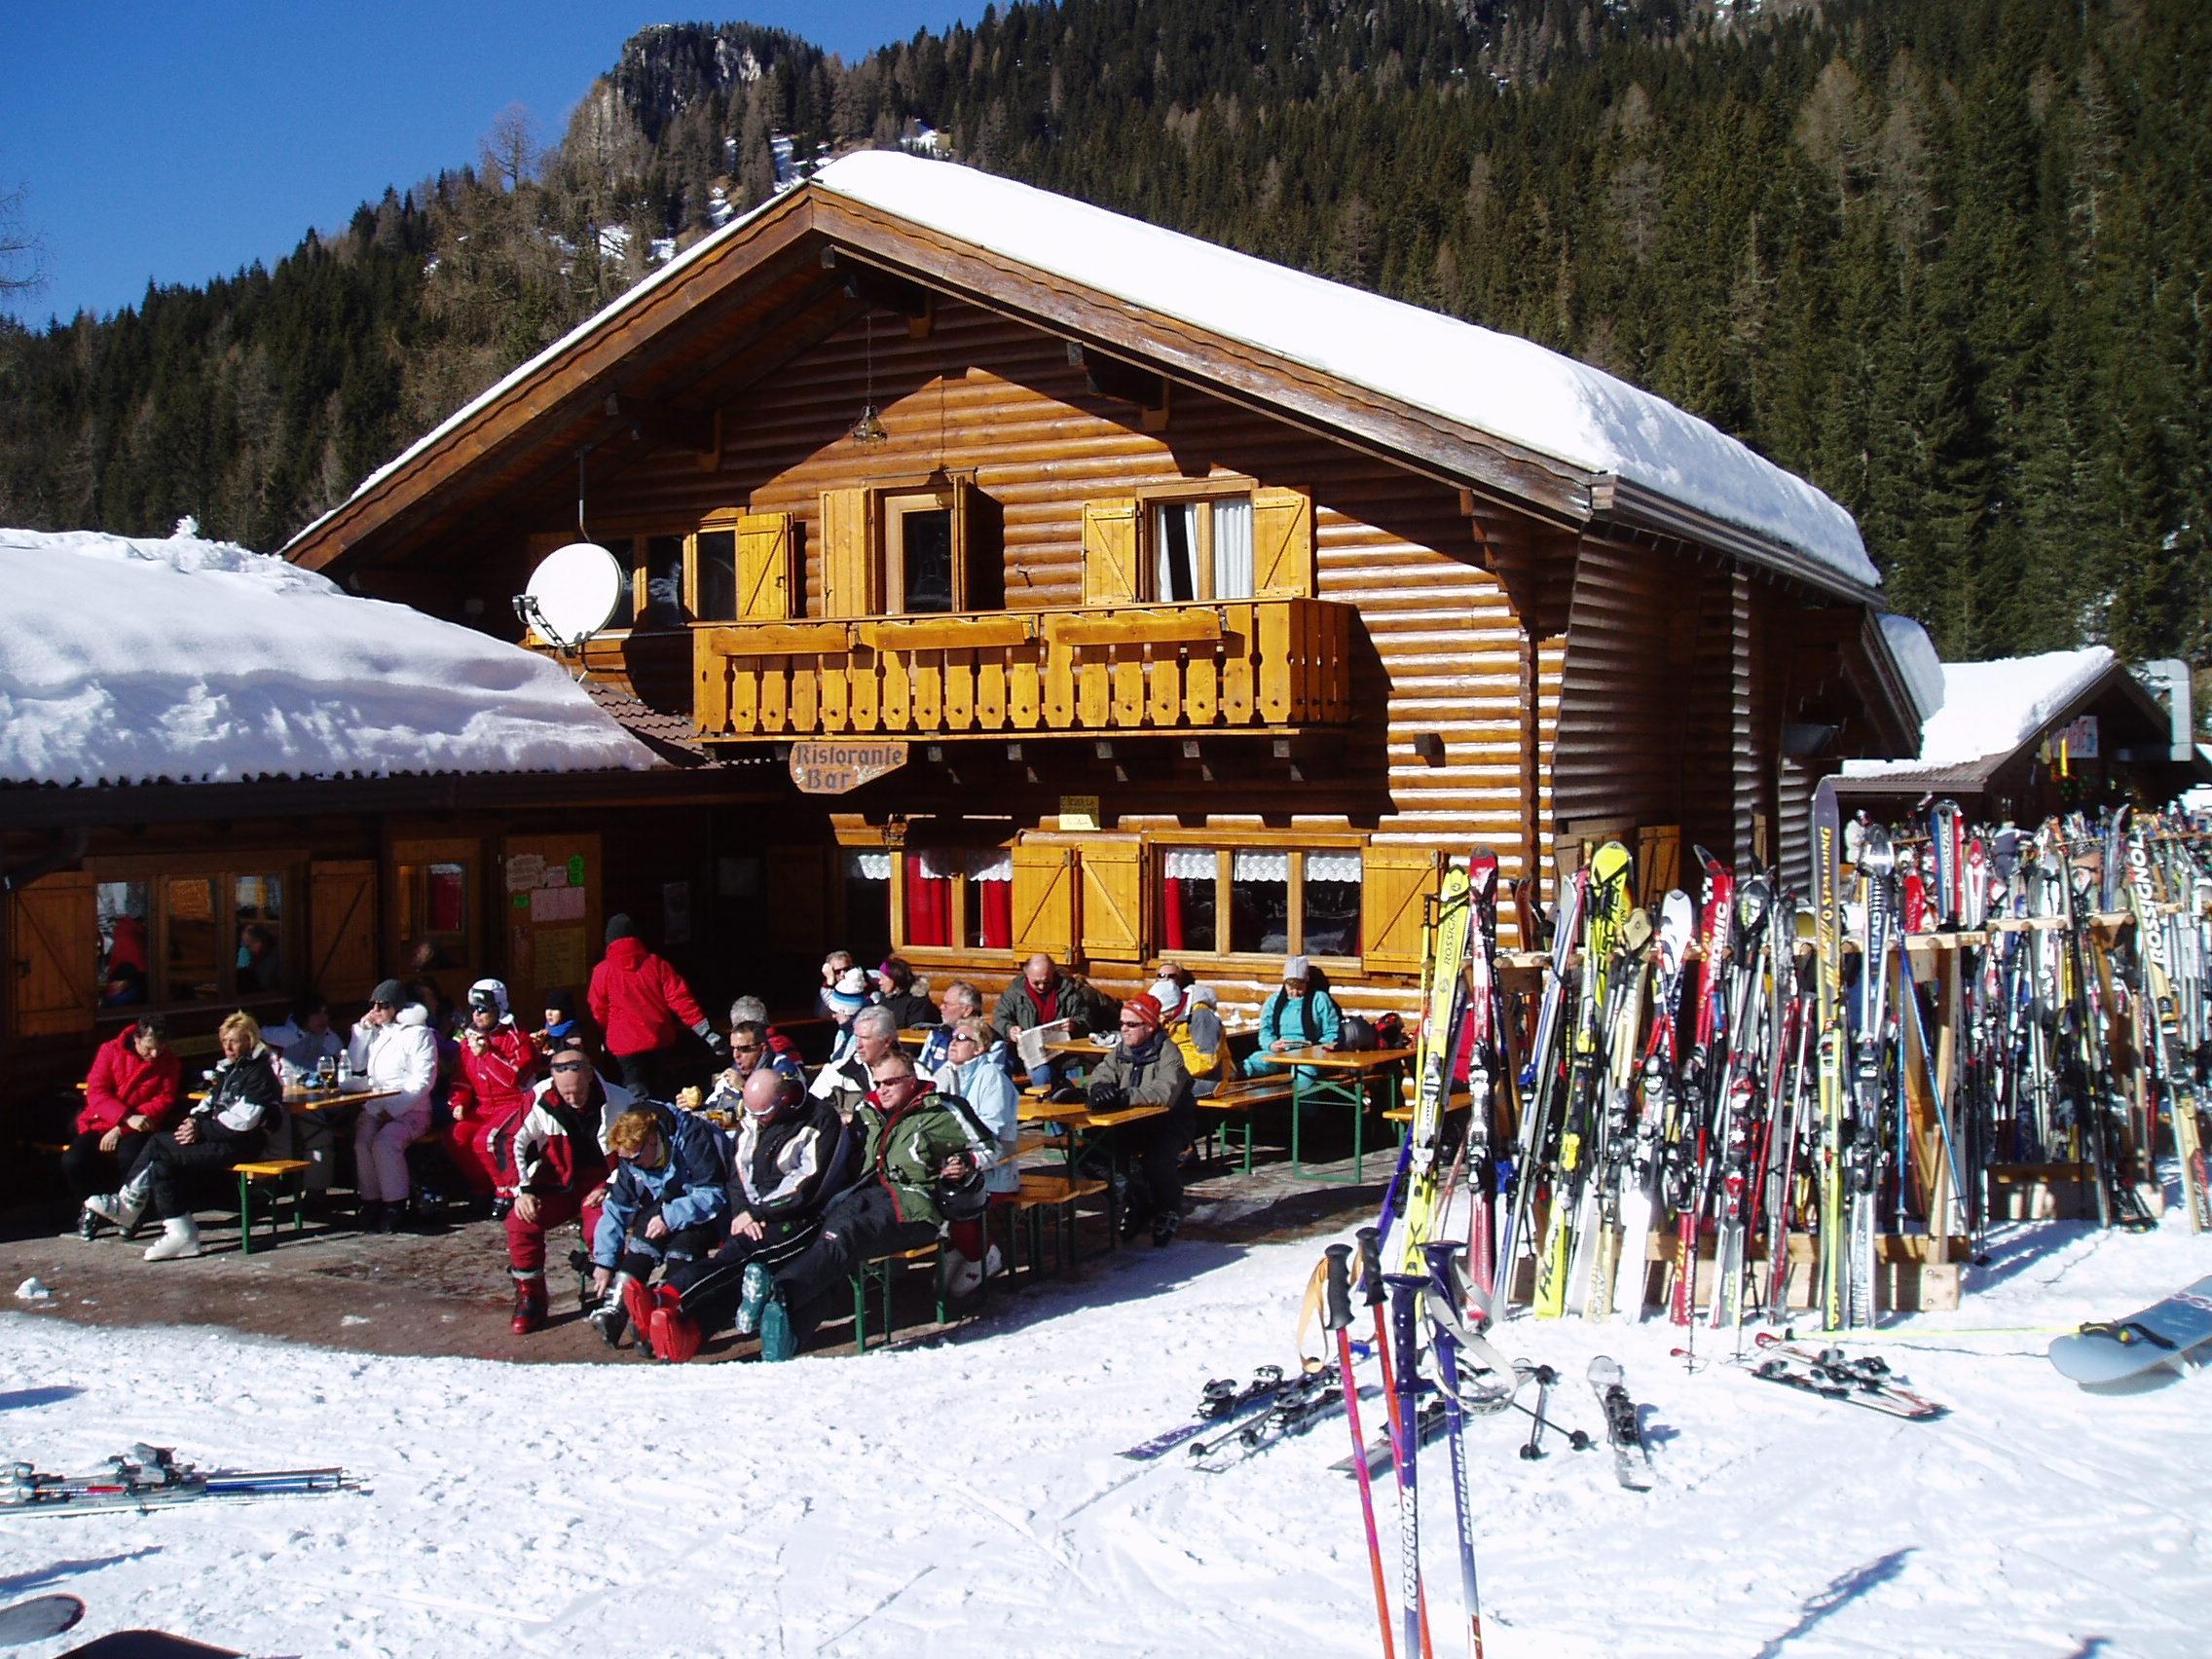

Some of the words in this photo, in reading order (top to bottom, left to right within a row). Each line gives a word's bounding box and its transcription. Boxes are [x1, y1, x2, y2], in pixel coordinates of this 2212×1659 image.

[796, 744, 903, 765] Ristorante
[807, 769, 851, 790] Bar
[1820, 826, 1833, 906] SPALDING
[2129, 832, 2166, 964] ROSSIGNOL
[1871, 914, 1883, 963] HEAD
[1402, 1485, 1418, 1612] ROSSIGNOL
